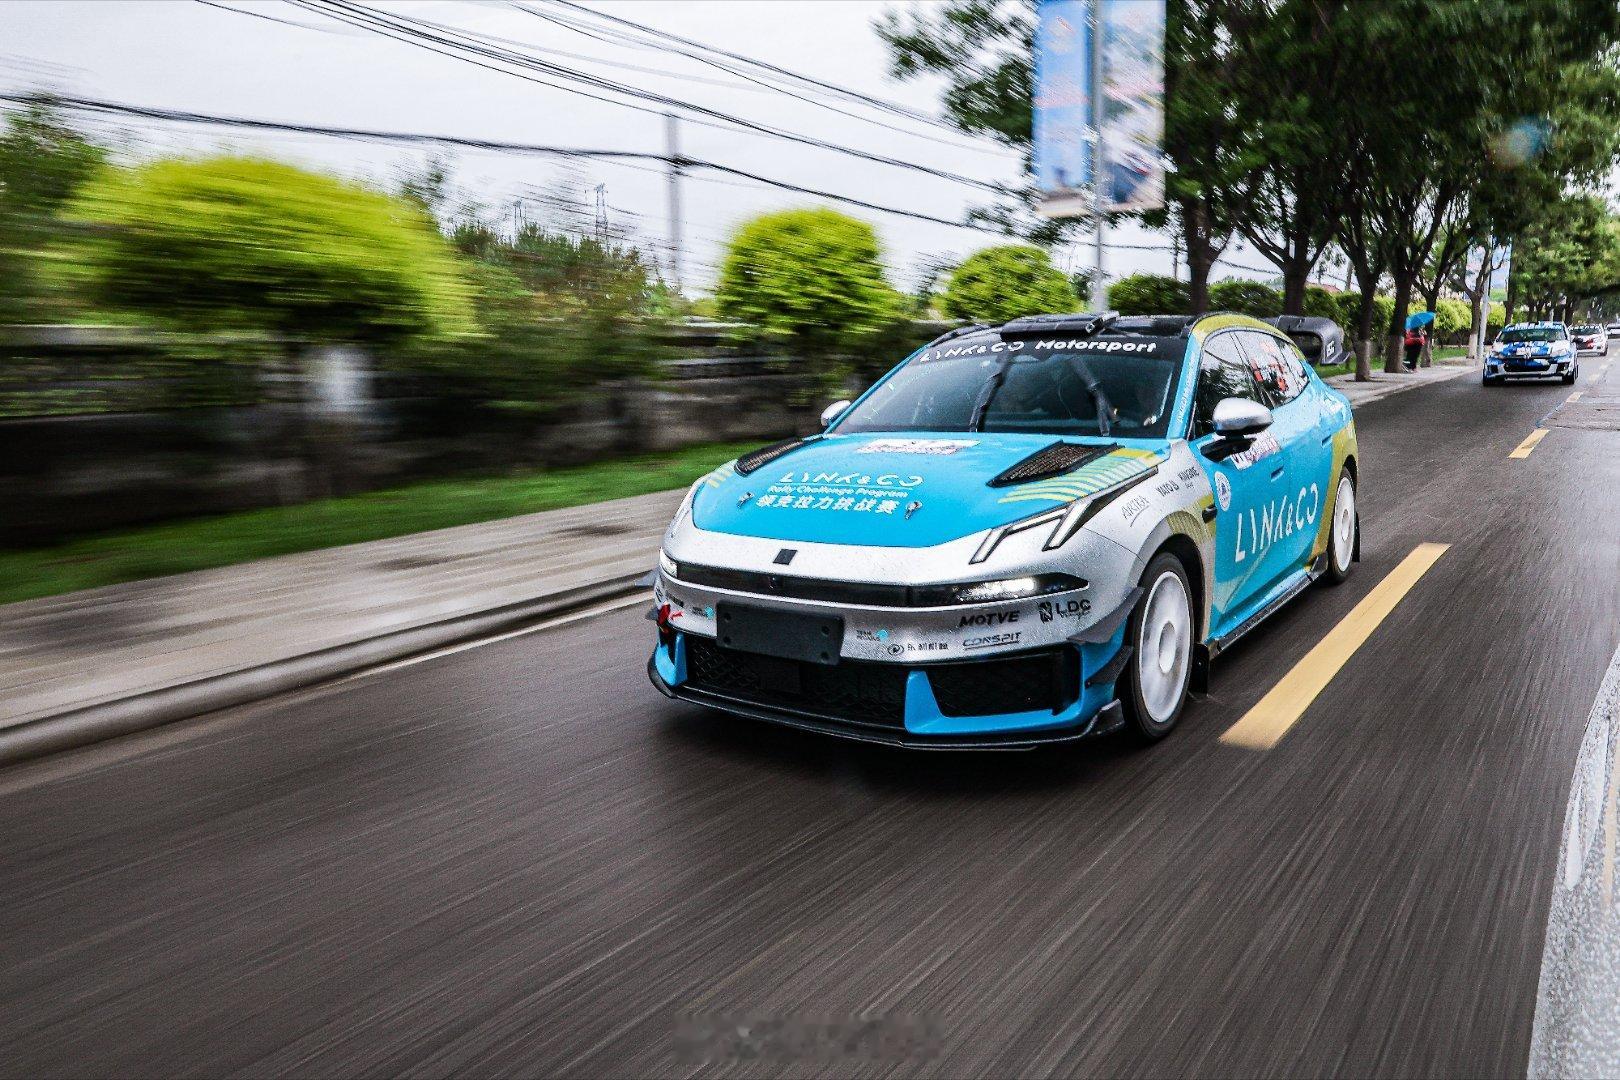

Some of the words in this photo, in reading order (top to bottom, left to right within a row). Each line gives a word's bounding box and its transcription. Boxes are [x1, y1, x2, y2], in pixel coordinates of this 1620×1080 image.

[1034, 339, 1157, 353] Motorsport
[796, 486, 854, 495] Challenge
[855, 487, 909, 498] Program
